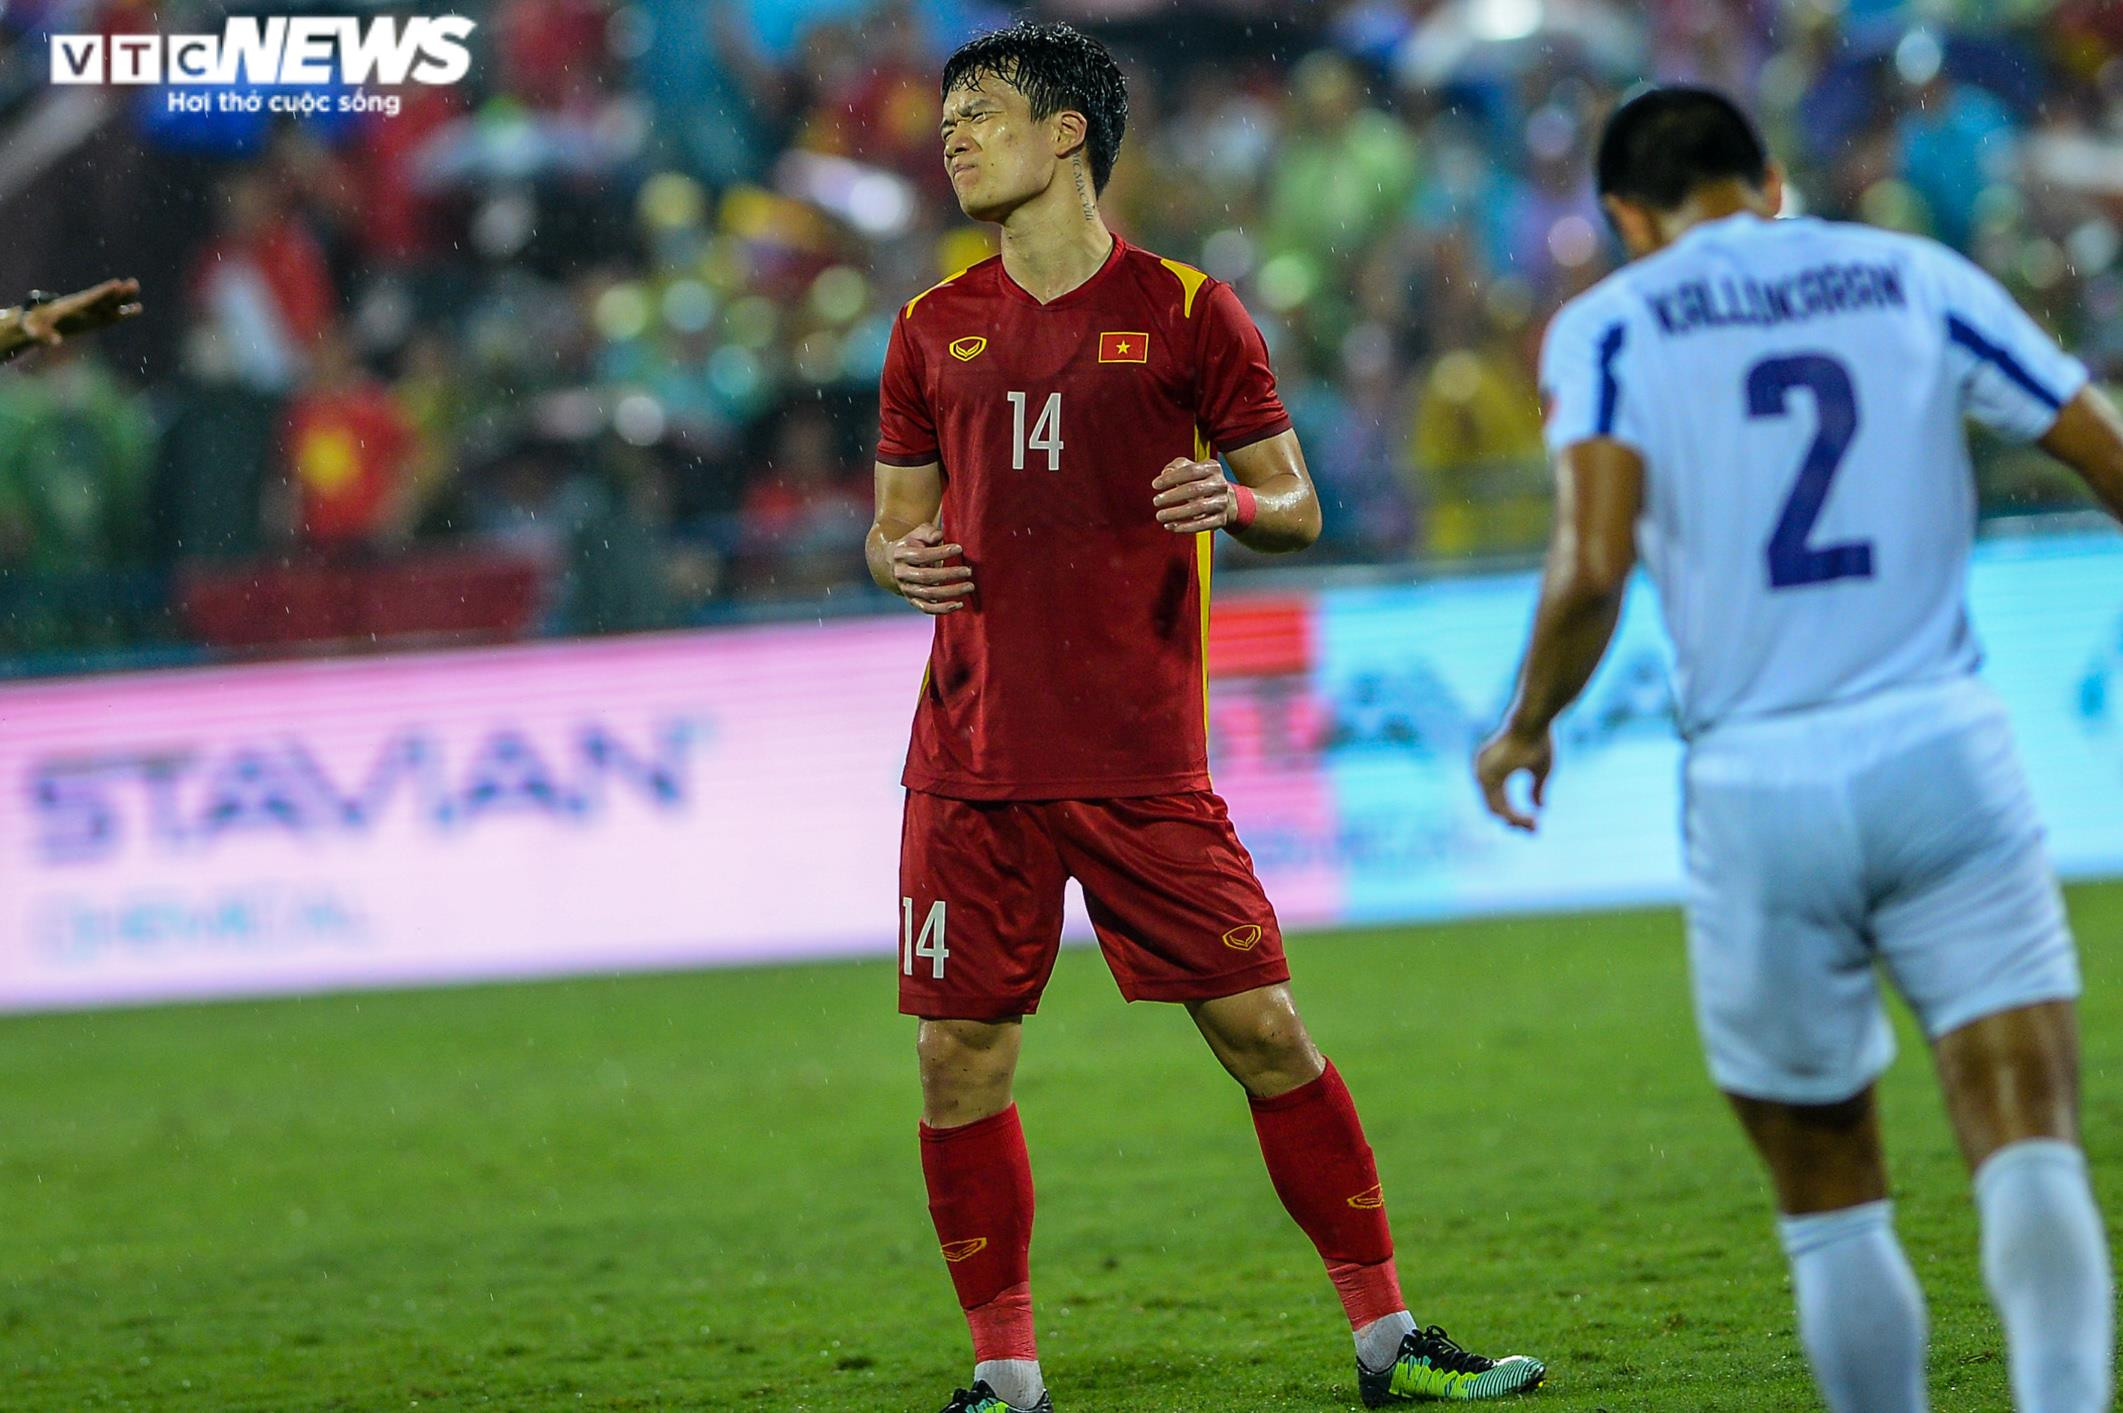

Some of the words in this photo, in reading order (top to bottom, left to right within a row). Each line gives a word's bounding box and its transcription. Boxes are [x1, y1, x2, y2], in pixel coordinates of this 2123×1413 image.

[1007, 390, 1064, 471] 14
[1745, 352, 1874, 588] 2
[902, 896, 950, 979] 14
